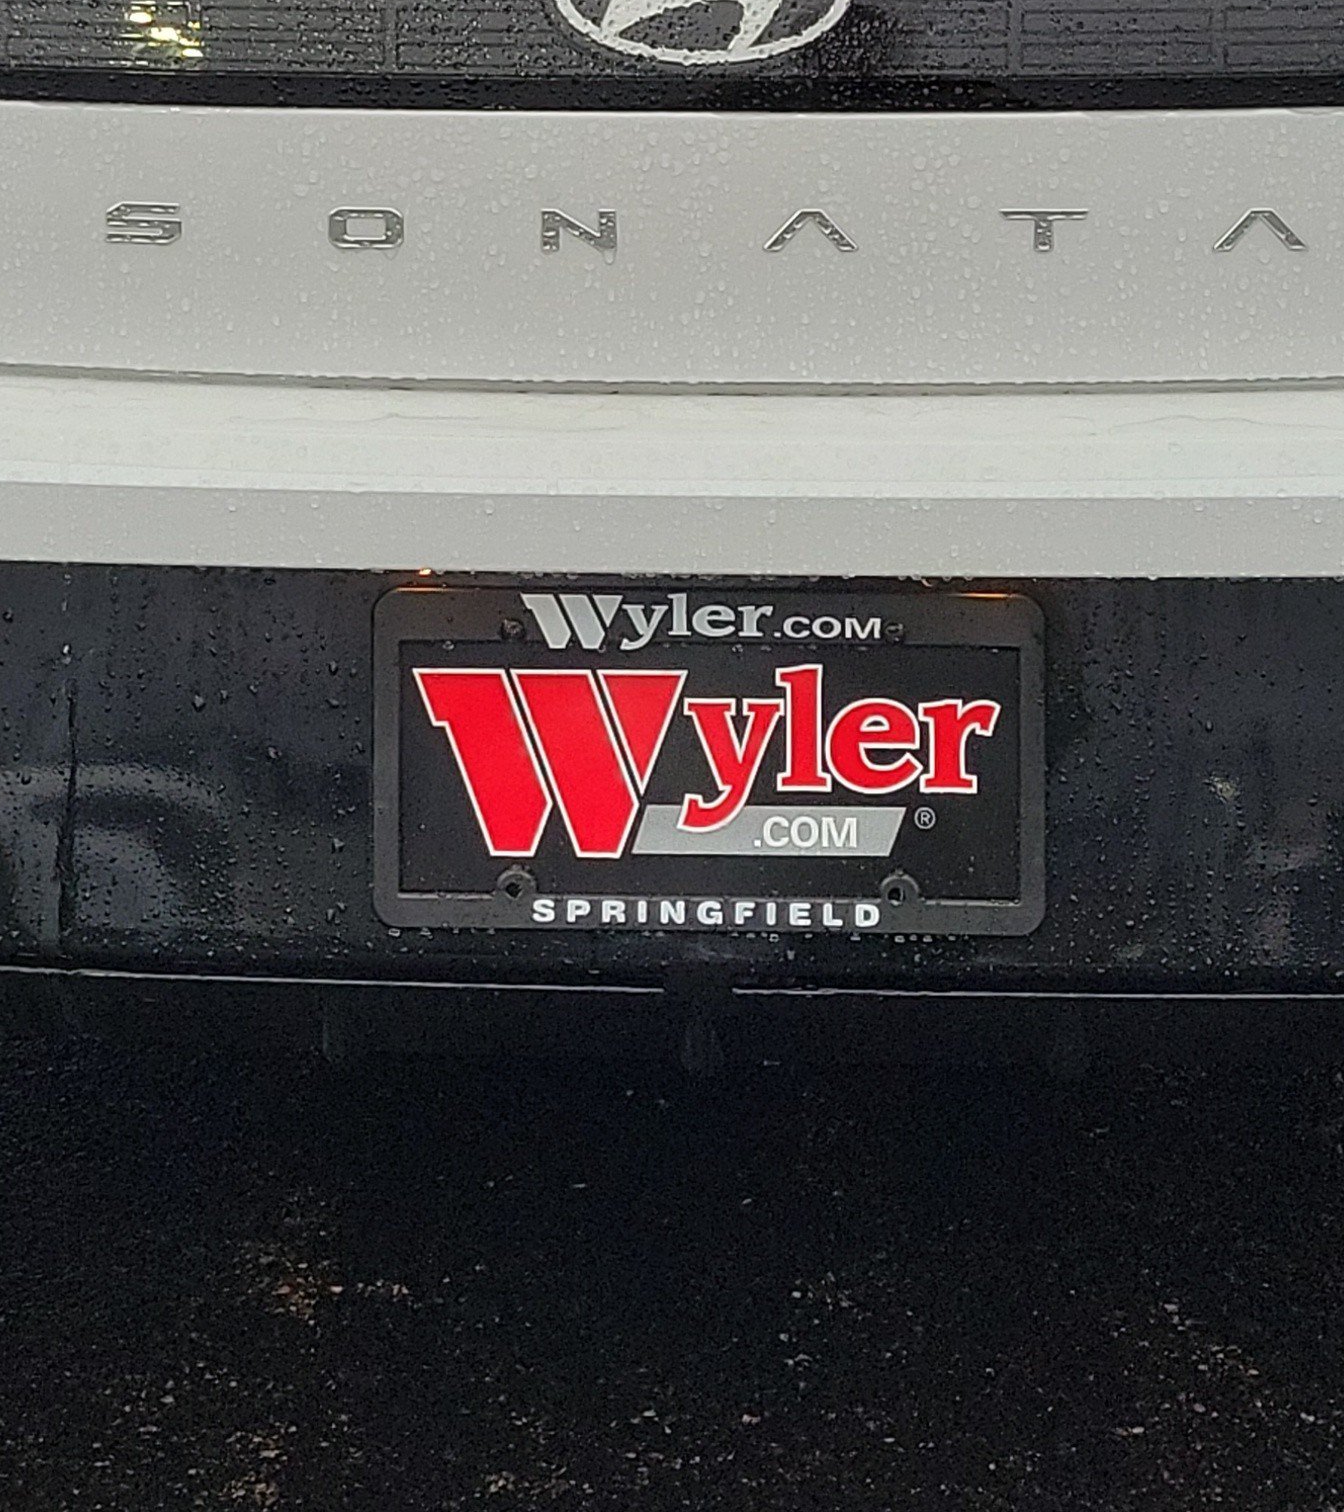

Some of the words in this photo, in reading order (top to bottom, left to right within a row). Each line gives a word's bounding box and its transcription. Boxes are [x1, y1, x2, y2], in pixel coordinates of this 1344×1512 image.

[103, 204, 1308, 253] SONATA
[413, 663, 1002, 859] Wyler
[532, 897, 882, 928] SPRINGFIELD
